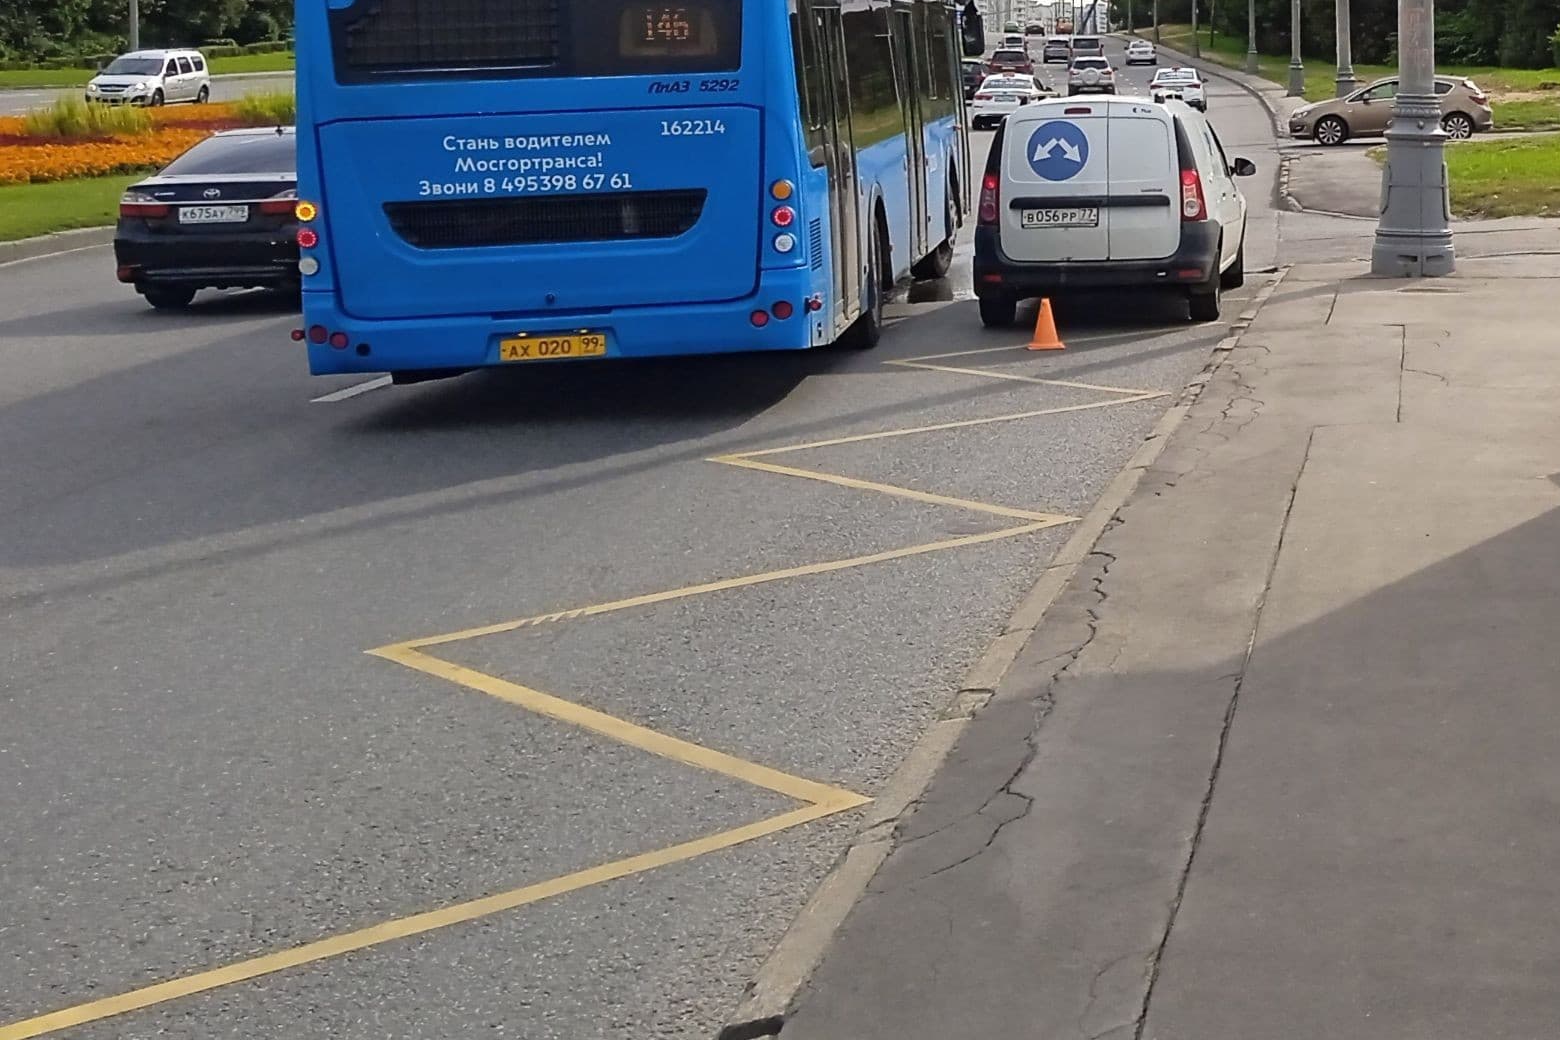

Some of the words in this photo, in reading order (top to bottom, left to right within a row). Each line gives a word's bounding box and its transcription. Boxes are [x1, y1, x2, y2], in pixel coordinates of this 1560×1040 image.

[645, 8, 689, 40] 146
[699, 79, 740, 92] 5292
[661, 119, 726, 136] 162214
[443, 135, 499, 151] Стань
[504, 133, 612, 150] водителем
[454, 152, 604, 173] Мосгортранса!
[419, 180, 479, 196] Звони
[484, 178, 496, 193] 8
[582, 174, 605, 190] 67
[610, 173, 633, 189] 61
[582, 336, 600, 349] 99
